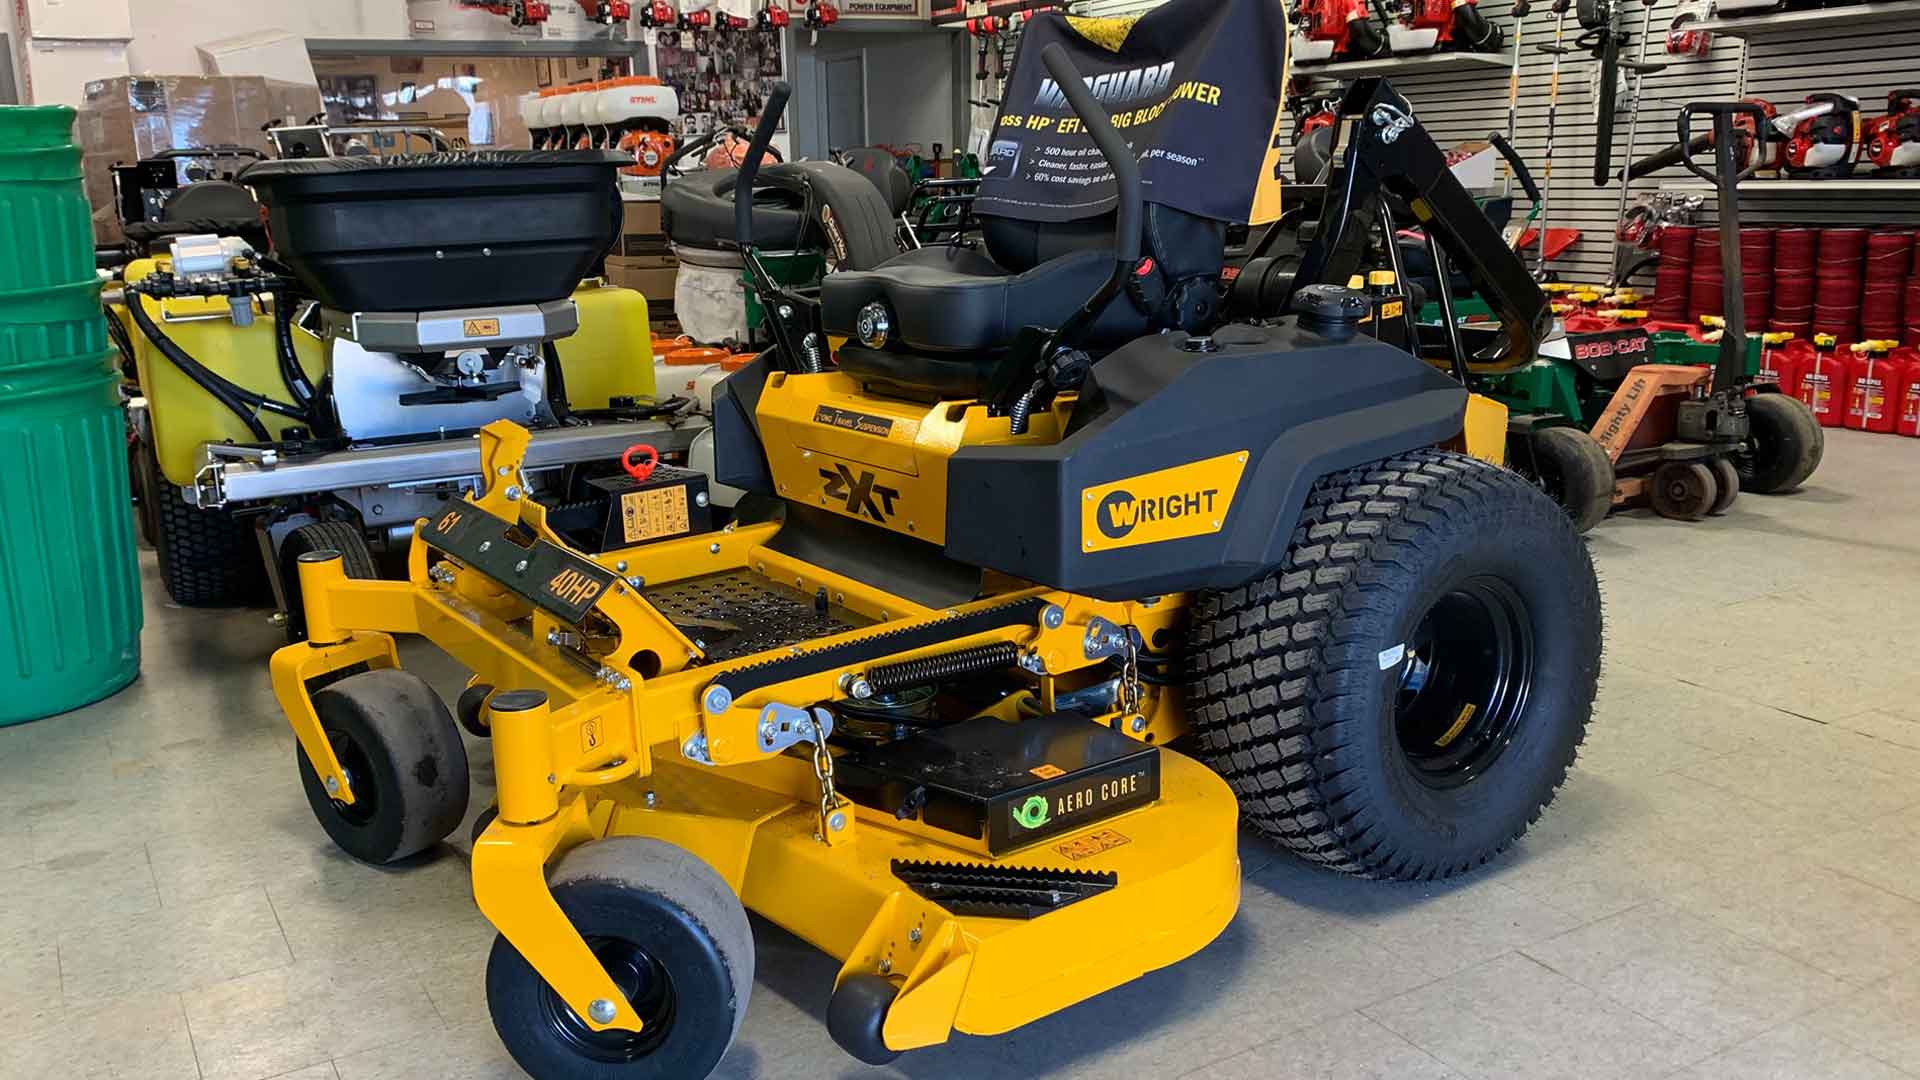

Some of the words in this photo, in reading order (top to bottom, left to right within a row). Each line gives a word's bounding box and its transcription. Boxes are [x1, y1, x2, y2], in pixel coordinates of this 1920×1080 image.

[1034, 61, 1175, 108] VAGUARD
[1044, 146, 1061, 156] 500
[1150, 148, 1165, 159] per
[1050, 174, 1067, 183] cost
[1574, 336, 1648, 360] BOB-CAT
[1099, 489, 1218, 537] WRIGHT
[549, 568, 601, 606] 40HP
[1057, 787, 1093, 817] AERO
